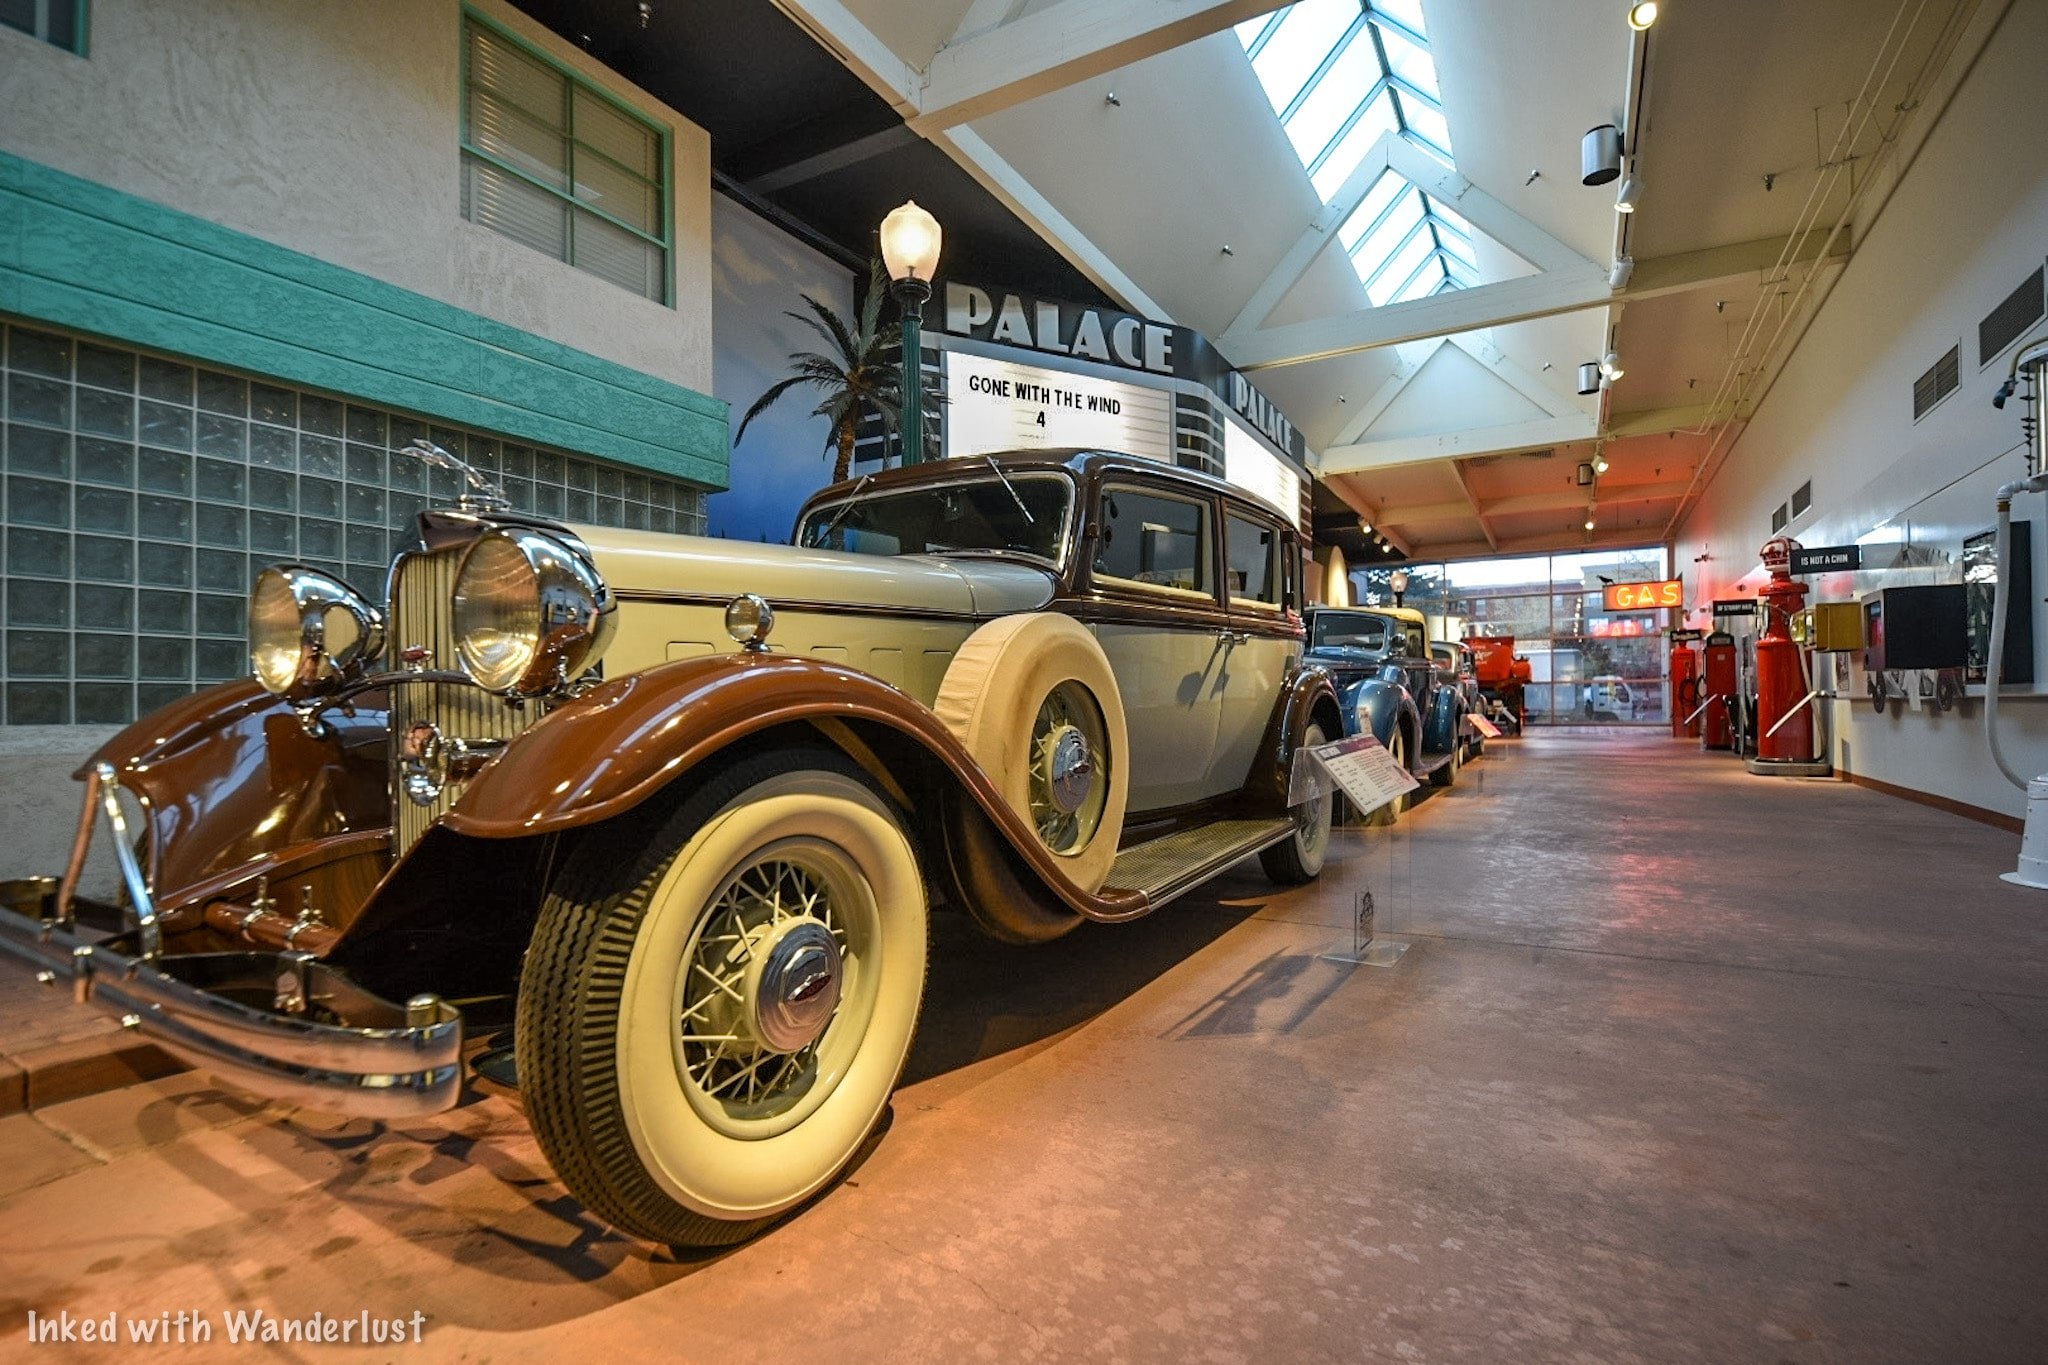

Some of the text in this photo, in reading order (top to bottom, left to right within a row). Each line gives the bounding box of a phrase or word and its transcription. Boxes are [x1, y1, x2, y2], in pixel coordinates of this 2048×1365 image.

[946, 281, 1174, 374] PALACE
[969, 375, 1121, 415] GONE WITH THE WIND
[1036, 410, 1046, 428] 4
[1231, 370, 1293, 456] PALACE
[1800, 556, 1809, 566] IS
[1809, 555, 1824, 565] NOT
[1824, 554, 1831, 565] A
[1616, 583, 1679, 607] GAS
